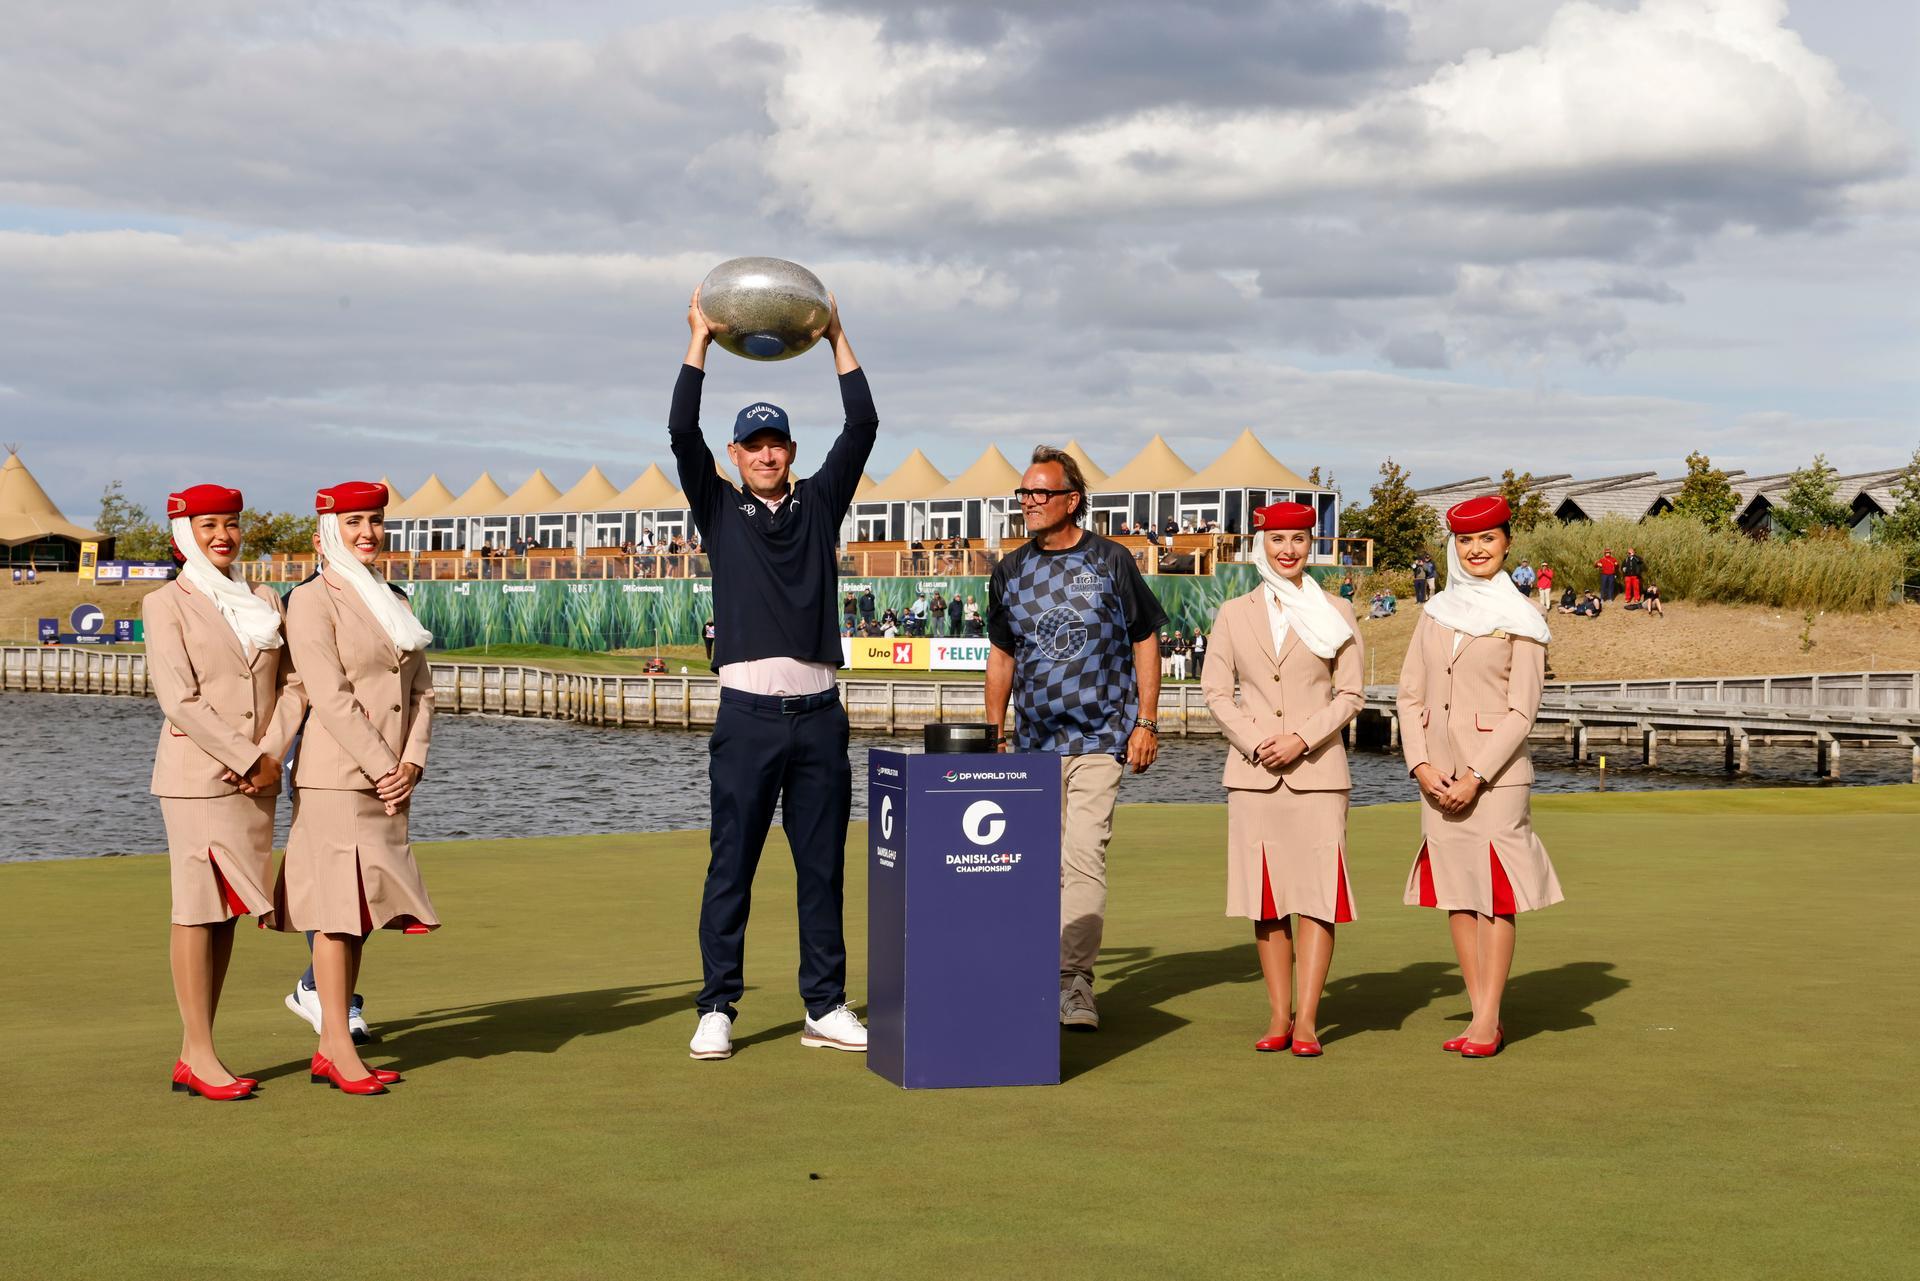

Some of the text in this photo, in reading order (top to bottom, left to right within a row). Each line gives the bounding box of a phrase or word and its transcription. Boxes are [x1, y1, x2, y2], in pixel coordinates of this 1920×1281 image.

[746, 405, 780, 419] Callaway
[567, 584, 593, 593] TRUST
[120, 621, 130, 629] 18
[868, 644, 911, 663] Uno X
[937, 646, 990, 661] 7-ELEVE
[959, 771, 1027, 780] DP WORLD TOUR
[956, 865, 1012, 873] CHAMPIONSHIP
